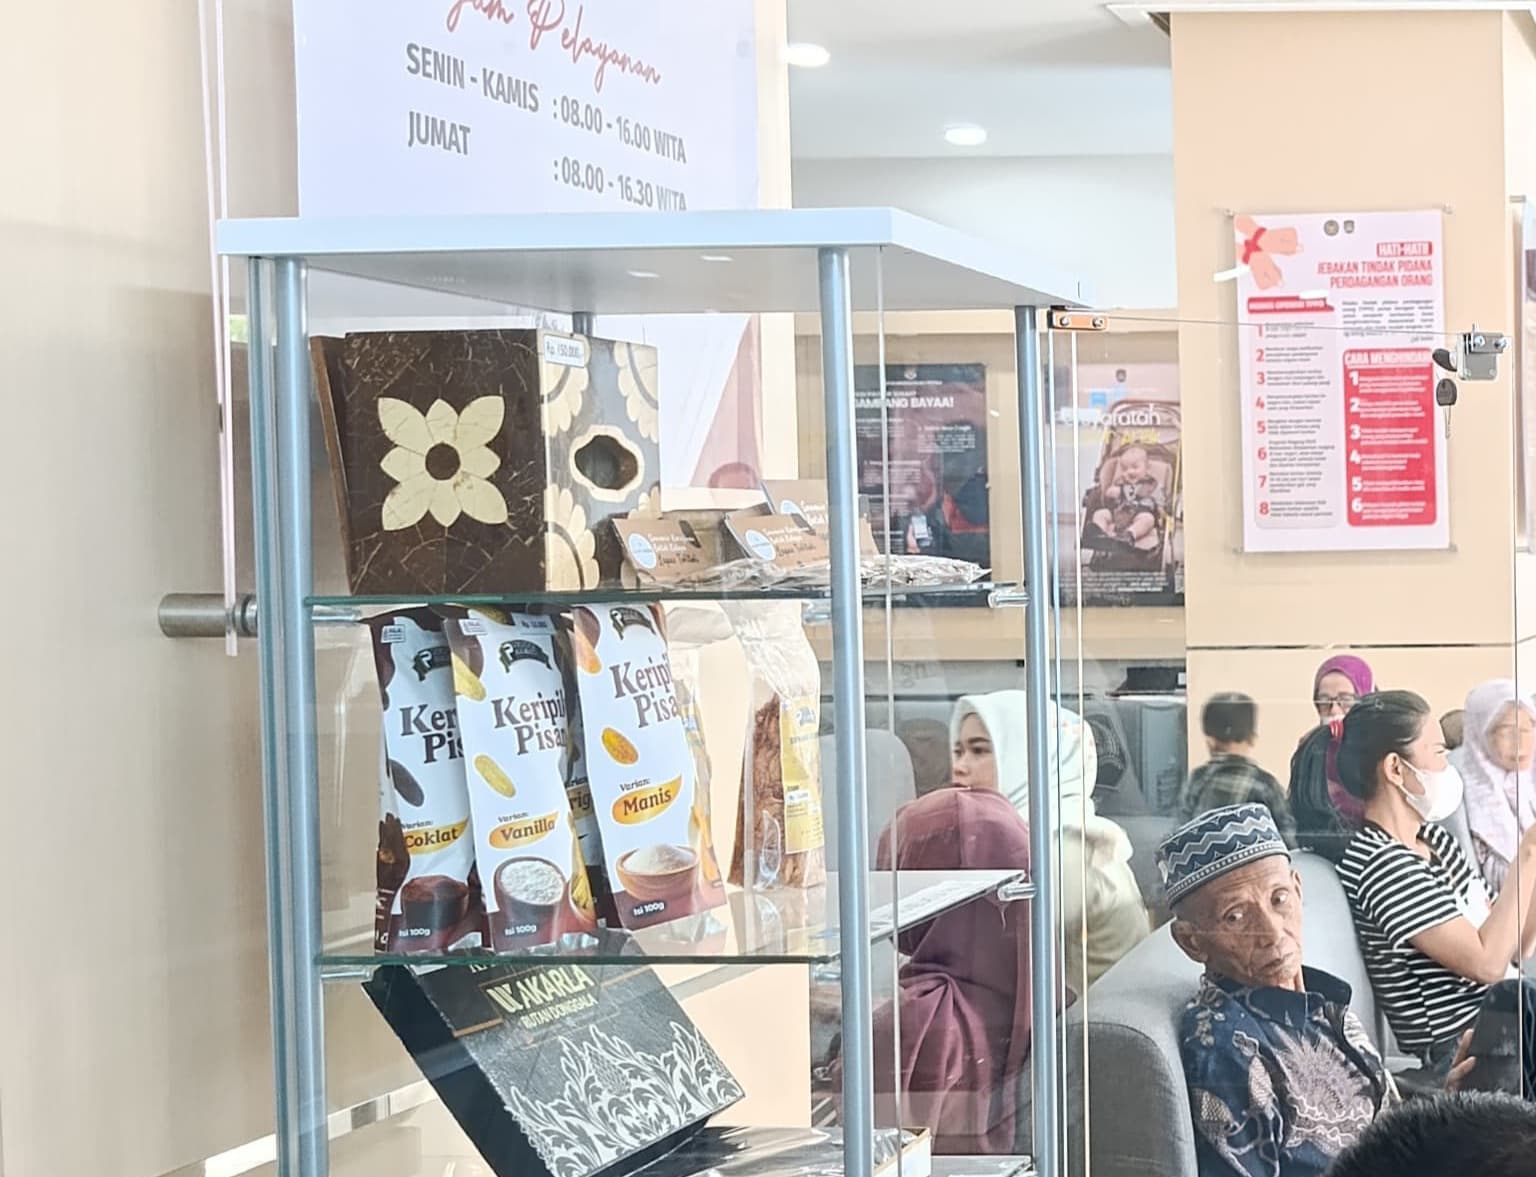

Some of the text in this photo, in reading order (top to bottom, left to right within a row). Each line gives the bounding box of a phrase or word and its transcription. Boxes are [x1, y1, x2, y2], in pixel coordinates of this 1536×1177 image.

[527, 0, 661, 92] Pelayanan
[406, 43, 465, 90] SENIN
[482, 67, 539, 113] KAMIS
[561, 95, 602, 134] 08.00
[616, 116, 651, 152] 16.00
[654, 129, 687, 163] WITA
[408, 111, 471, 155] JUMAT
[562, 157, 603, 193] 08.00
[618, 175, 652, 208] 16.30
[656, 185, 687, 211] WITA
[1256, 349, 1264, 362] 2
[1257, 372, 1265, 385] 3
[1350, 373, 1358, 386] 1
[1350, 399, 1361, 412] 2
[1256, 421, 1265, 434] 5
[1351, 426, 1361, 440] 3
[1257, 447, 1267, 461] 6
[1350, 451, 1361, 464] 4
[1258, 475, 1267, 488] 7
[1352, 477, 1362, 491] 5
[1259, 502, 1269, 515] 8
[1352, 499, 1363, 512] 6
[623, 787, 672, 816] Manis
[500, 817, 556, 842] Vanilla
[404, 826, 459, 849] Coklat
[410, 927, 431, 937] 100g
[516, 924, 537, 934] 100g
